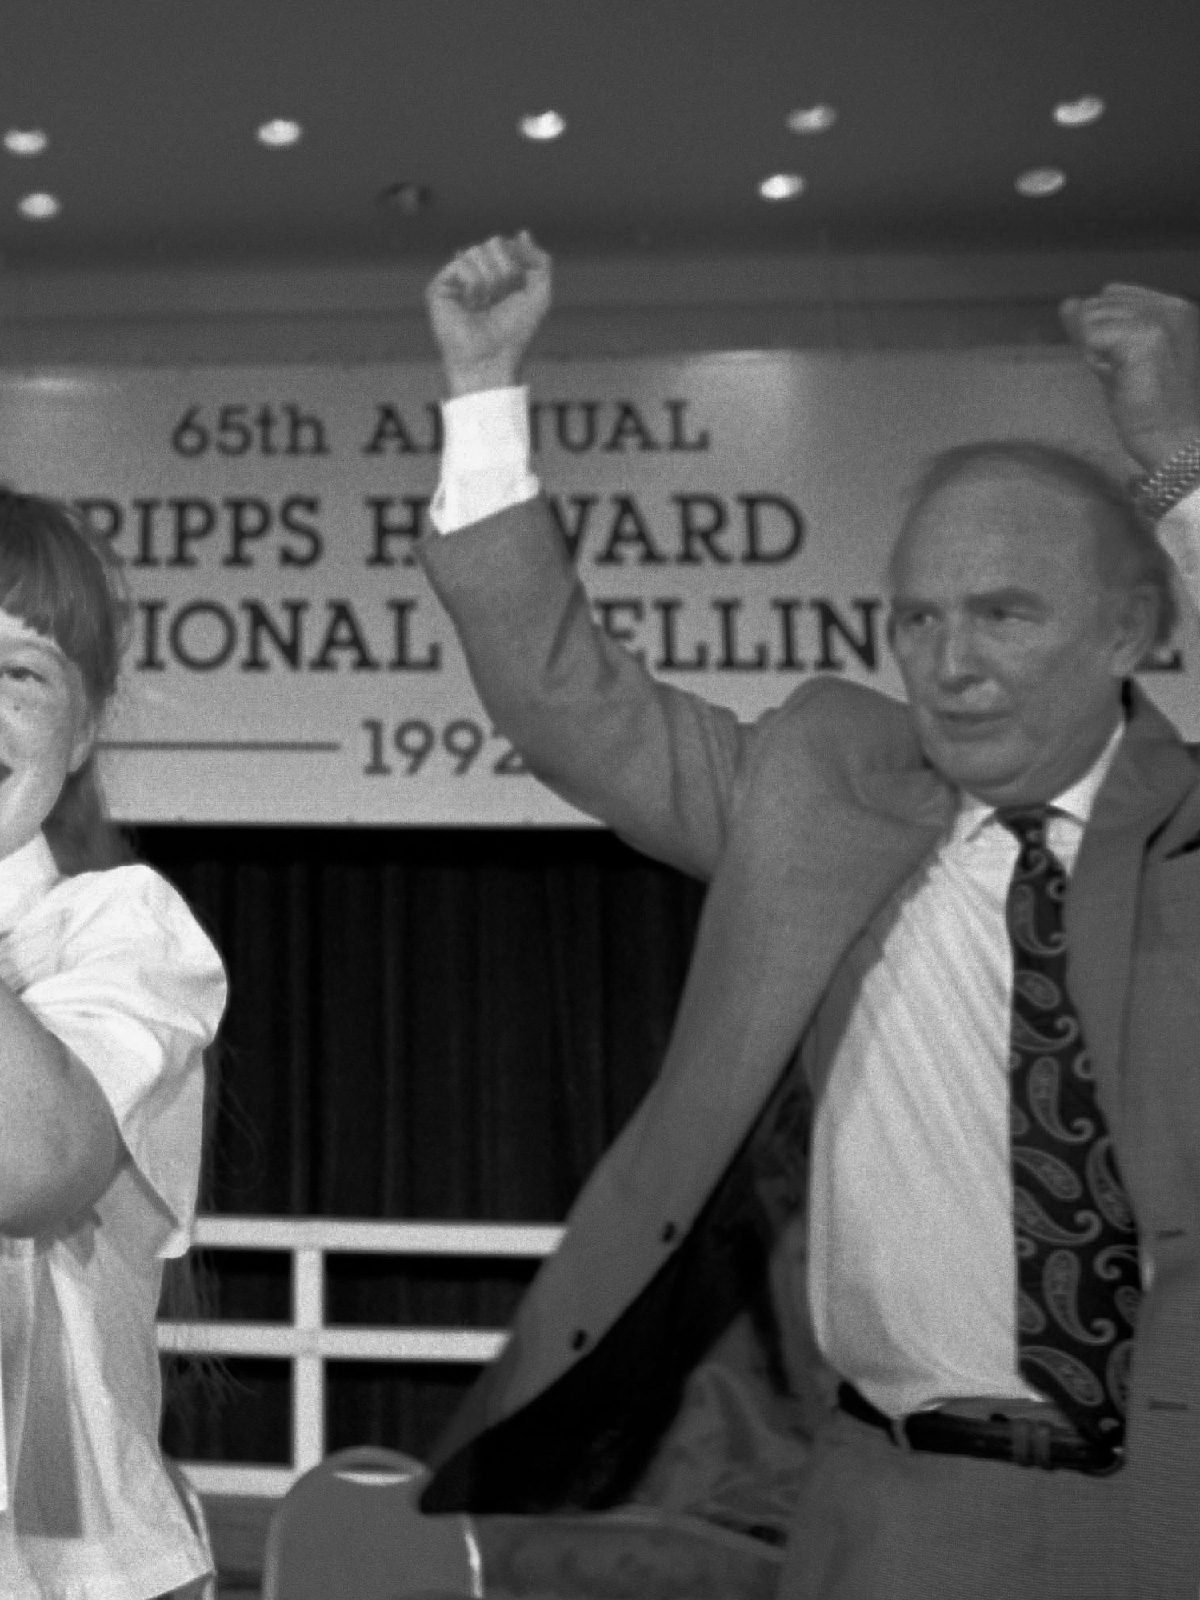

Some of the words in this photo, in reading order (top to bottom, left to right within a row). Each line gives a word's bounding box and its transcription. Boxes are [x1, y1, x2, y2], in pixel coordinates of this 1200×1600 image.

[171, 403, 331, 457] 65th
[363, 399, 711, 453] AUAL
[74, 497, 324, 568] RIPPS
[364, 493, 807, 568] HWARD
[135, 600, 443, 672] IONAL
[594, 597, 883, 673] ELLIN
